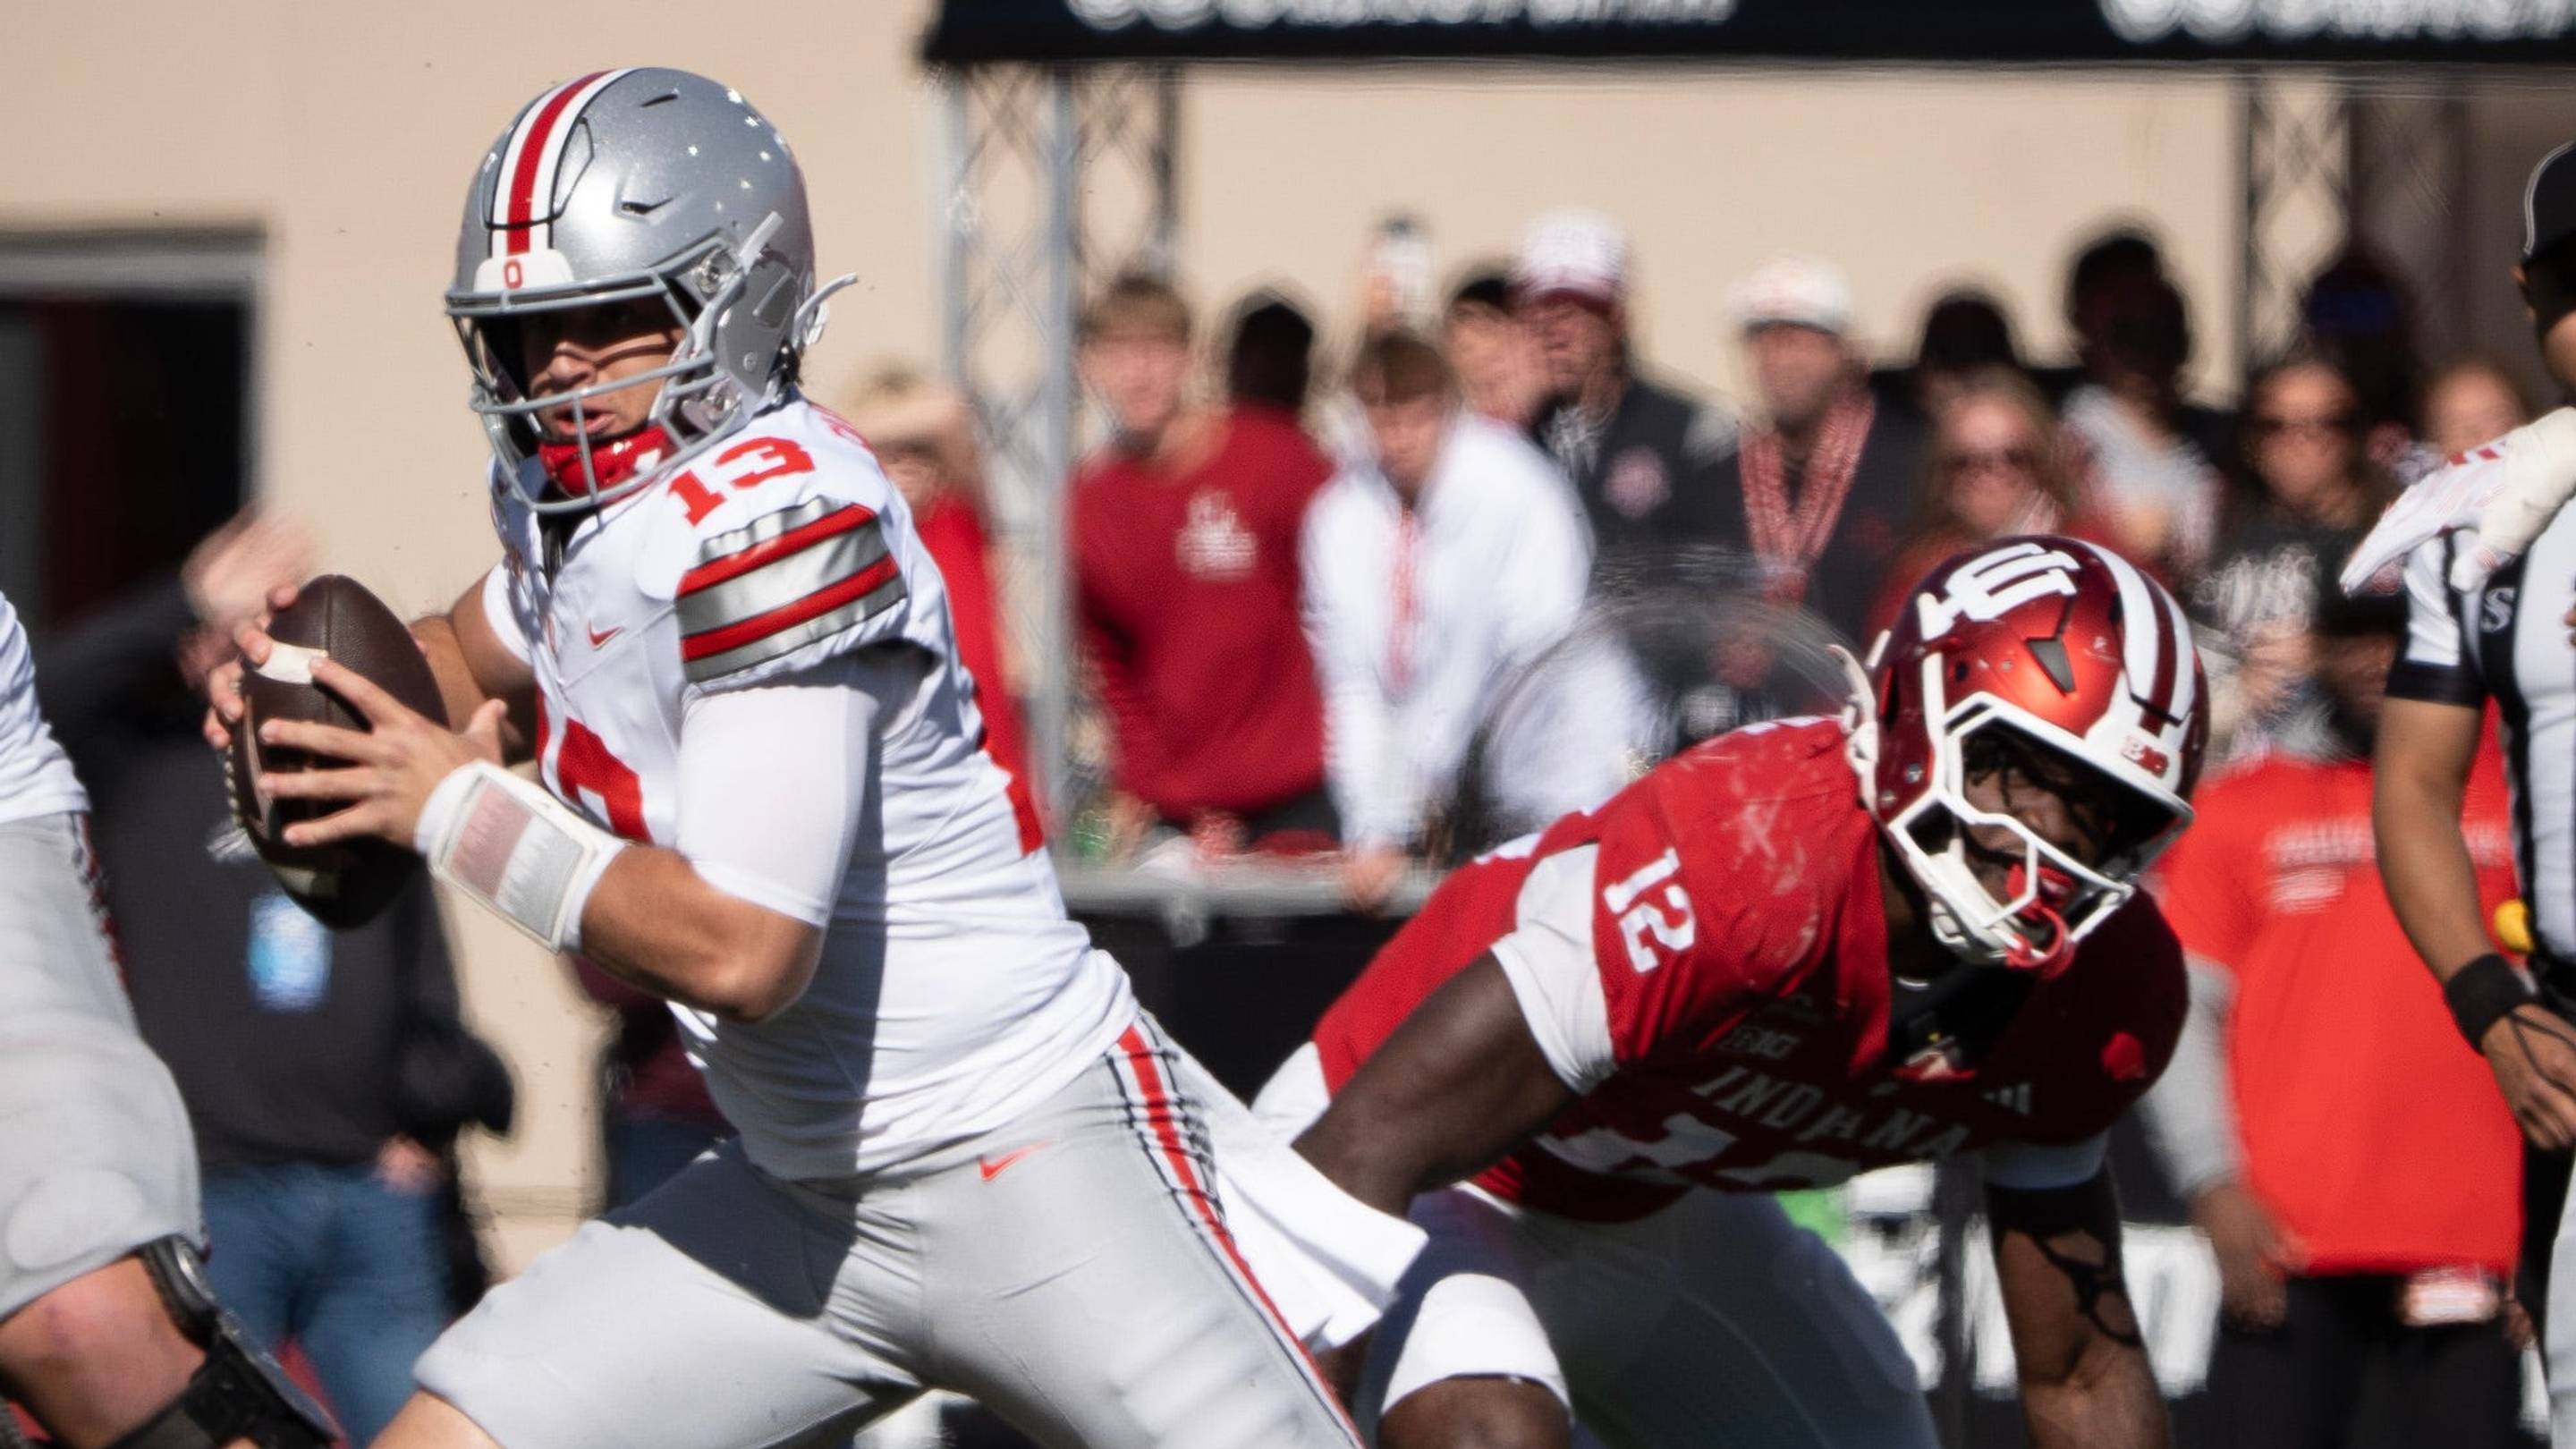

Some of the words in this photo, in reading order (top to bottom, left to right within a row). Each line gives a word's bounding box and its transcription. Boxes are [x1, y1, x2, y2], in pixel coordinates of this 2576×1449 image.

[667, 436, 815, 527] 13
[2480, 588, 2512, 634] S
[1603, 847, 1697, 970] 12
[1689, 1064, 1970, 1161] INDIANA
